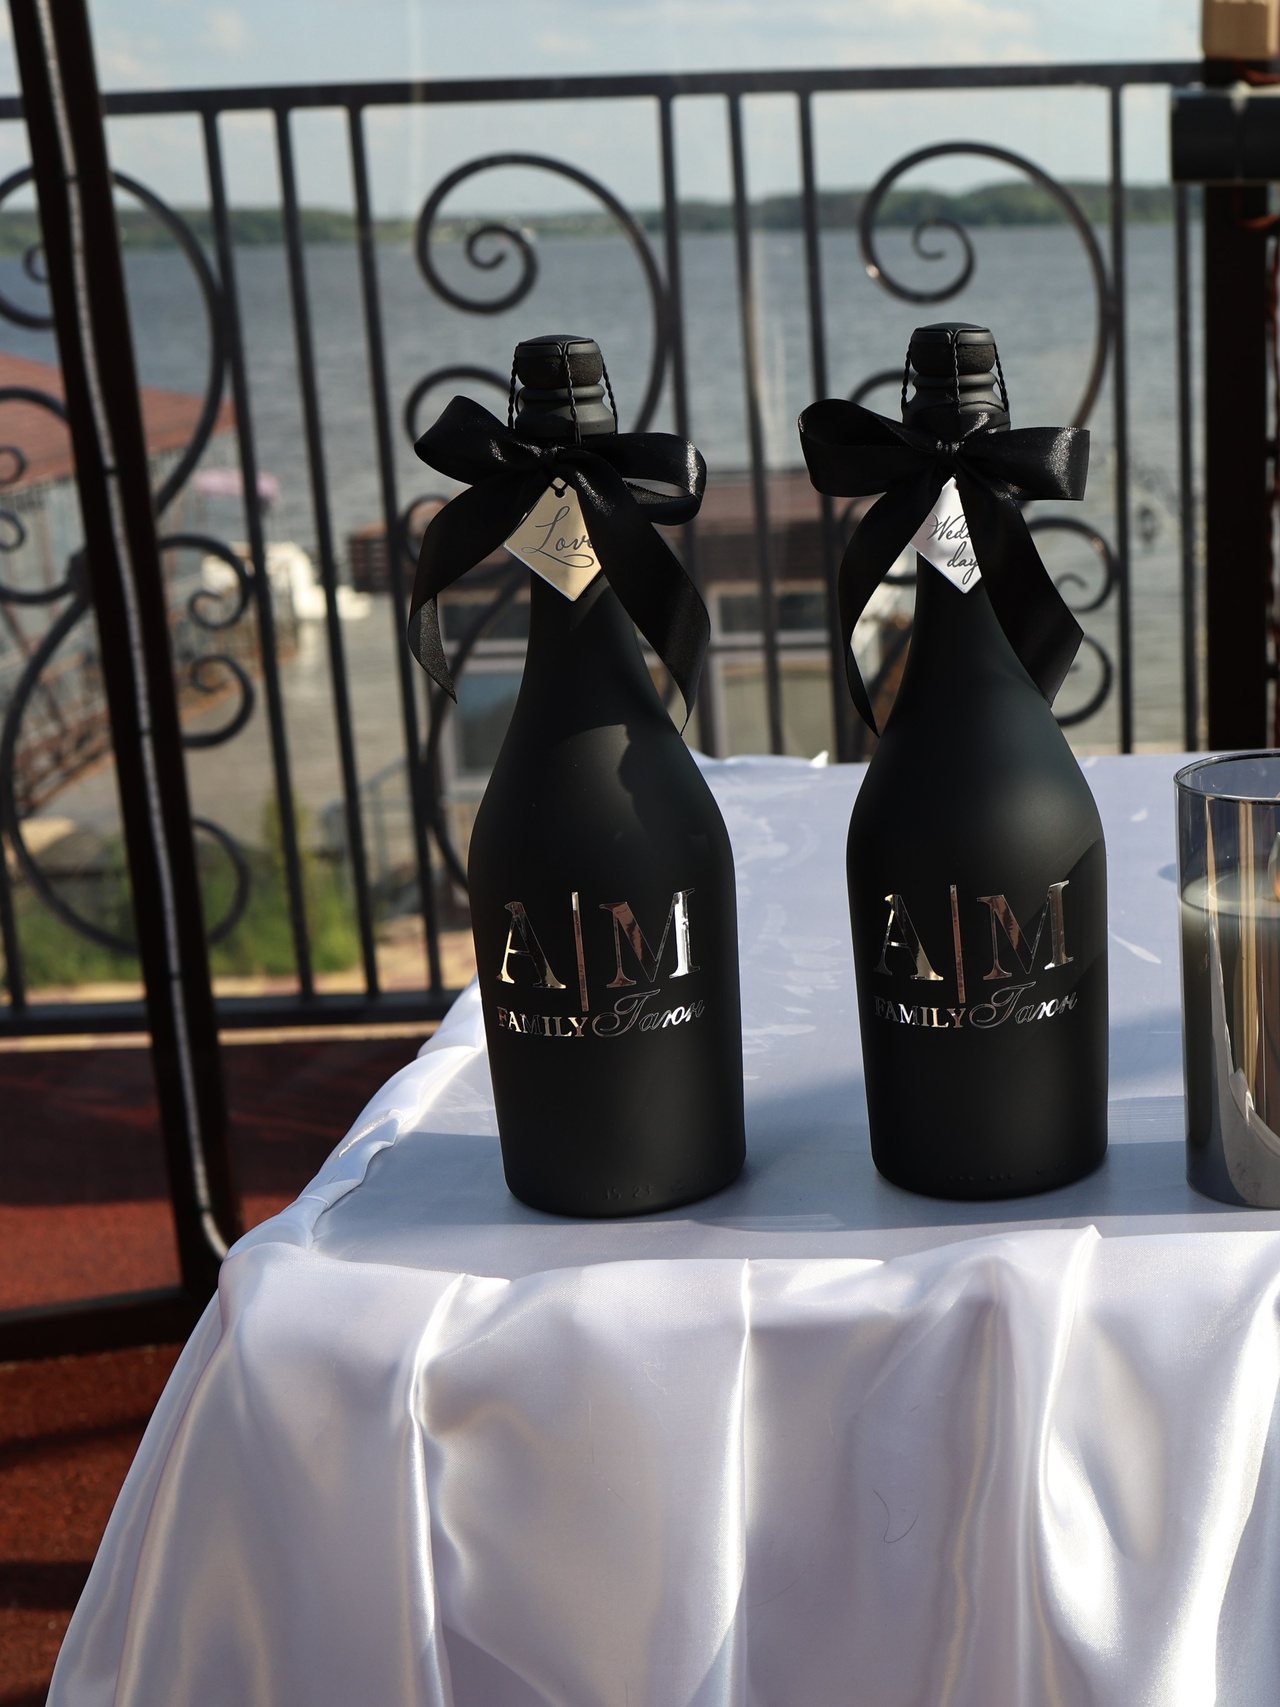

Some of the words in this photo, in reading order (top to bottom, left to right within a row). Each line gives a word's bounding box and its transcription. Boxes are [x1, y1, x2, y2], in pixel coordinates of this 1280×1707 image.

[946, 540, 979, 585] day
[496, 1005, 589, 1037] FAMILY
[874, 994, 967, 1029] FAMILY
